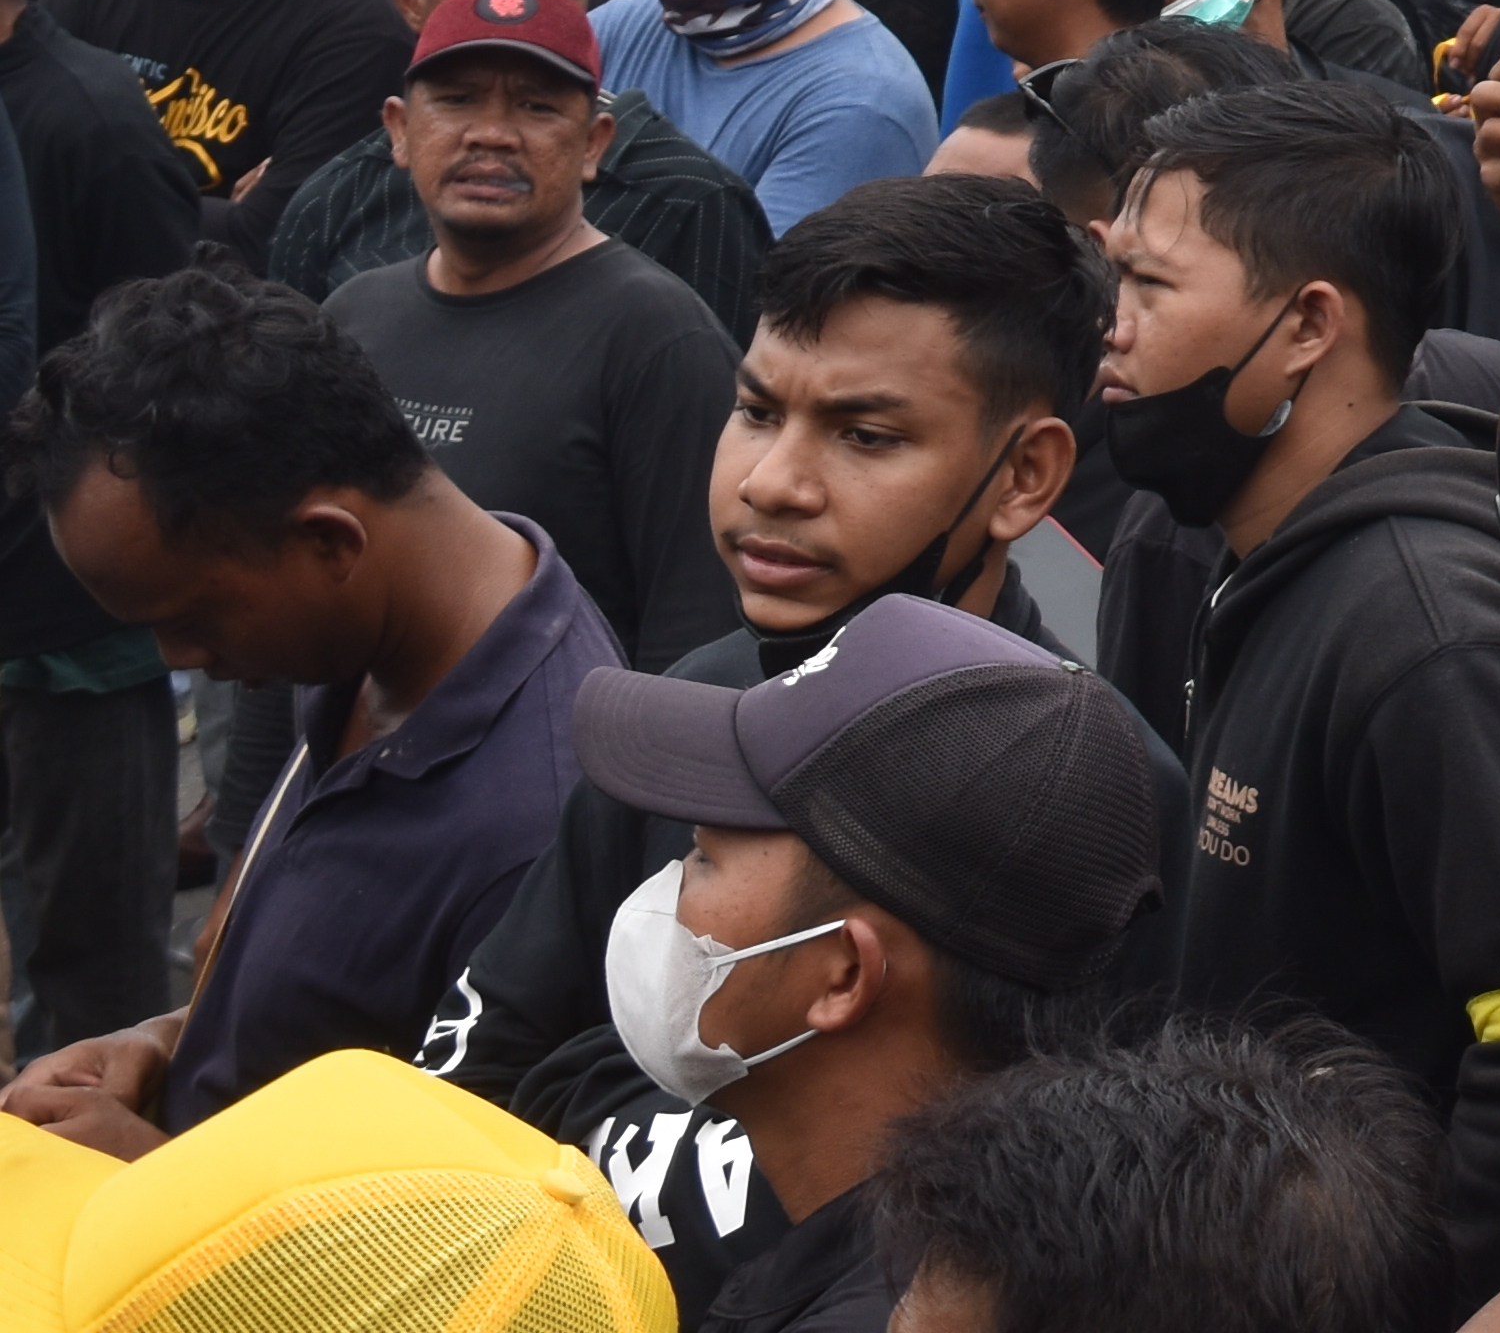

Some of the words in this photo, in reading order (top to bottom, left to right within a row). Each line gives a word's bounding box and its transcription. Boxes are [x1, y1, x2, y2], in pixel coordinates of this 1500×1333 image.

[1207, 765, 1259, 814] REAMS
[1199, 828, 1219, 856] OU
[1220, 839, 1251, 867] DO
